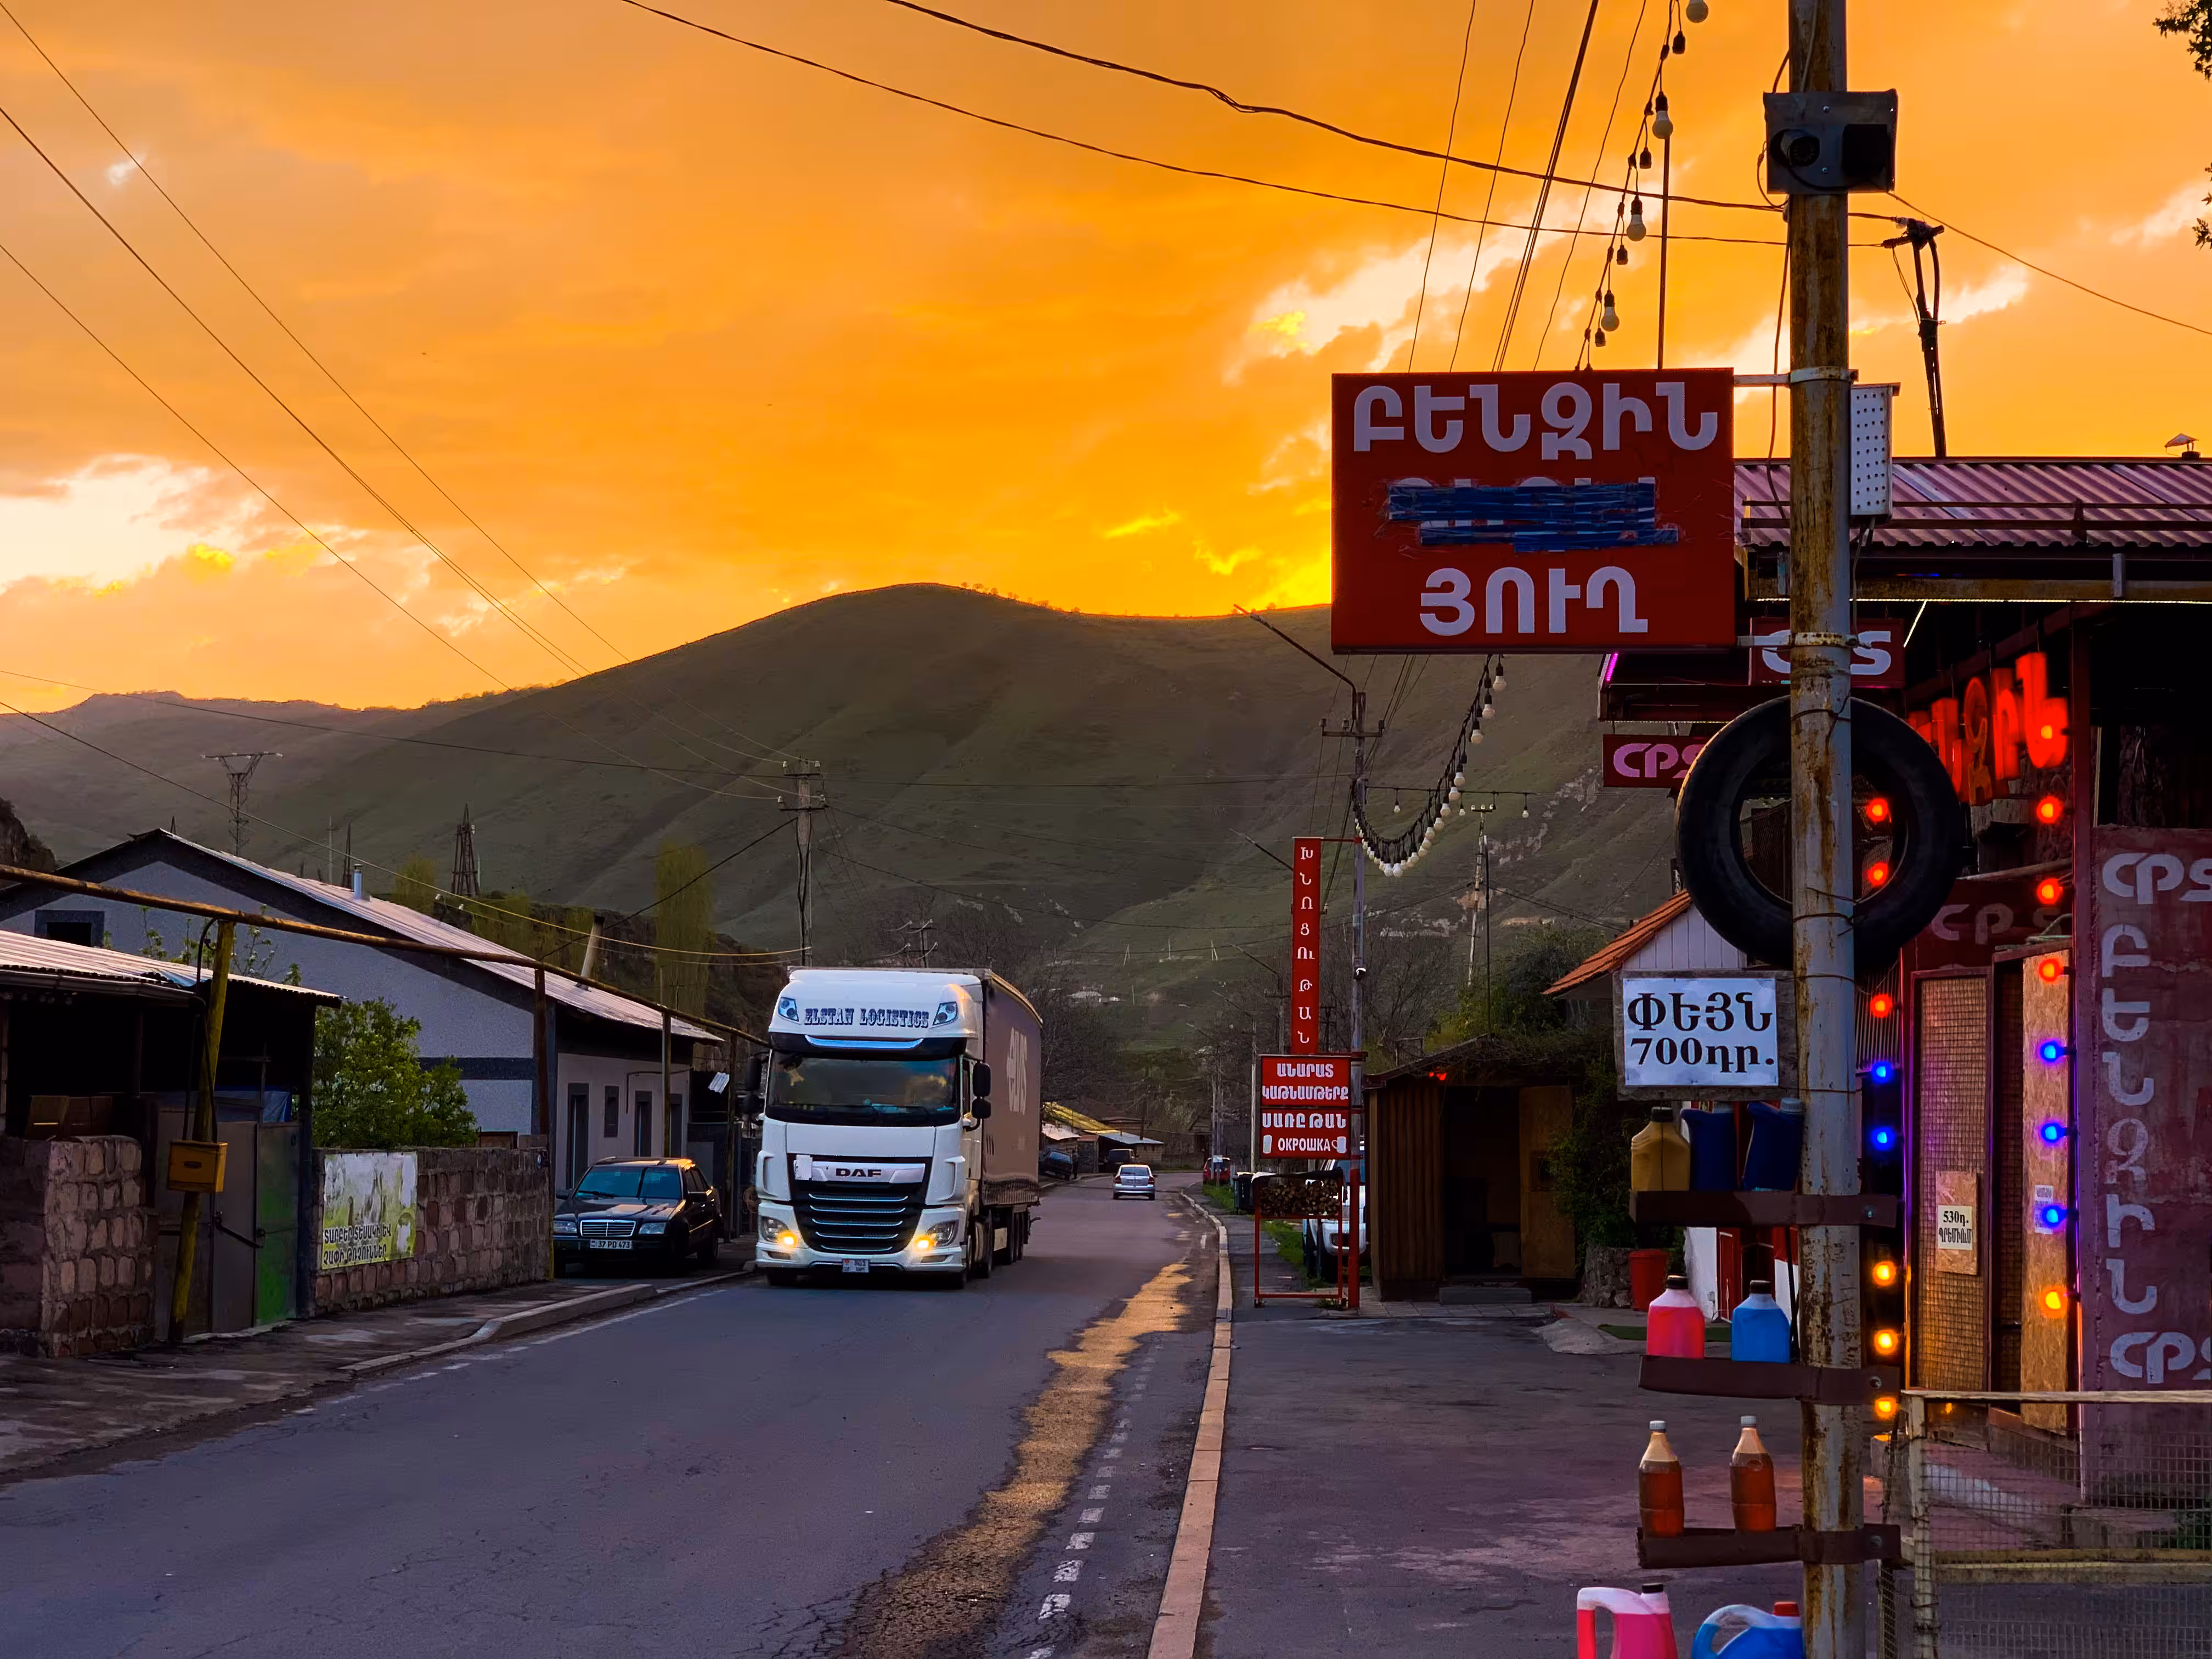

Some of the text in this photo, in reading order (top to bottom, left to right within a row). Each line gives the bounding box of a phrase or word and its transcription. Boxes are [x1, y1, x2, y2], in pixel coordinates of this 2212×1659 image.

[1353, 382, 1718, 460] ԲԵՆԶԻՆ
[1420, 566, 1648, 636] ՅՈՒՂ
[1762, 629, 1892, 675] CS
[859, 1008, 929, 1029] LOGISTICS
[1627, 992, 1773, 1032] ՓԵՅՆ
[1630, 1037, 1774, 1073] 700դր.
[1277, 1063, 1334, 1078] ԱՆԱՐԱՏ
[1262, 1113, 1346, 1128] ՍԱՌԸ ԹԱՆ
[1278, 1137, 1331, 1152] ОКРОШКА
[836, 1168, 882, 1177] DAF
[324, 1227, 352, 1244] ՏԱՐԲԵՐ
[354, 1224, 380, 1240] ՏԵՍԱԿԻ
